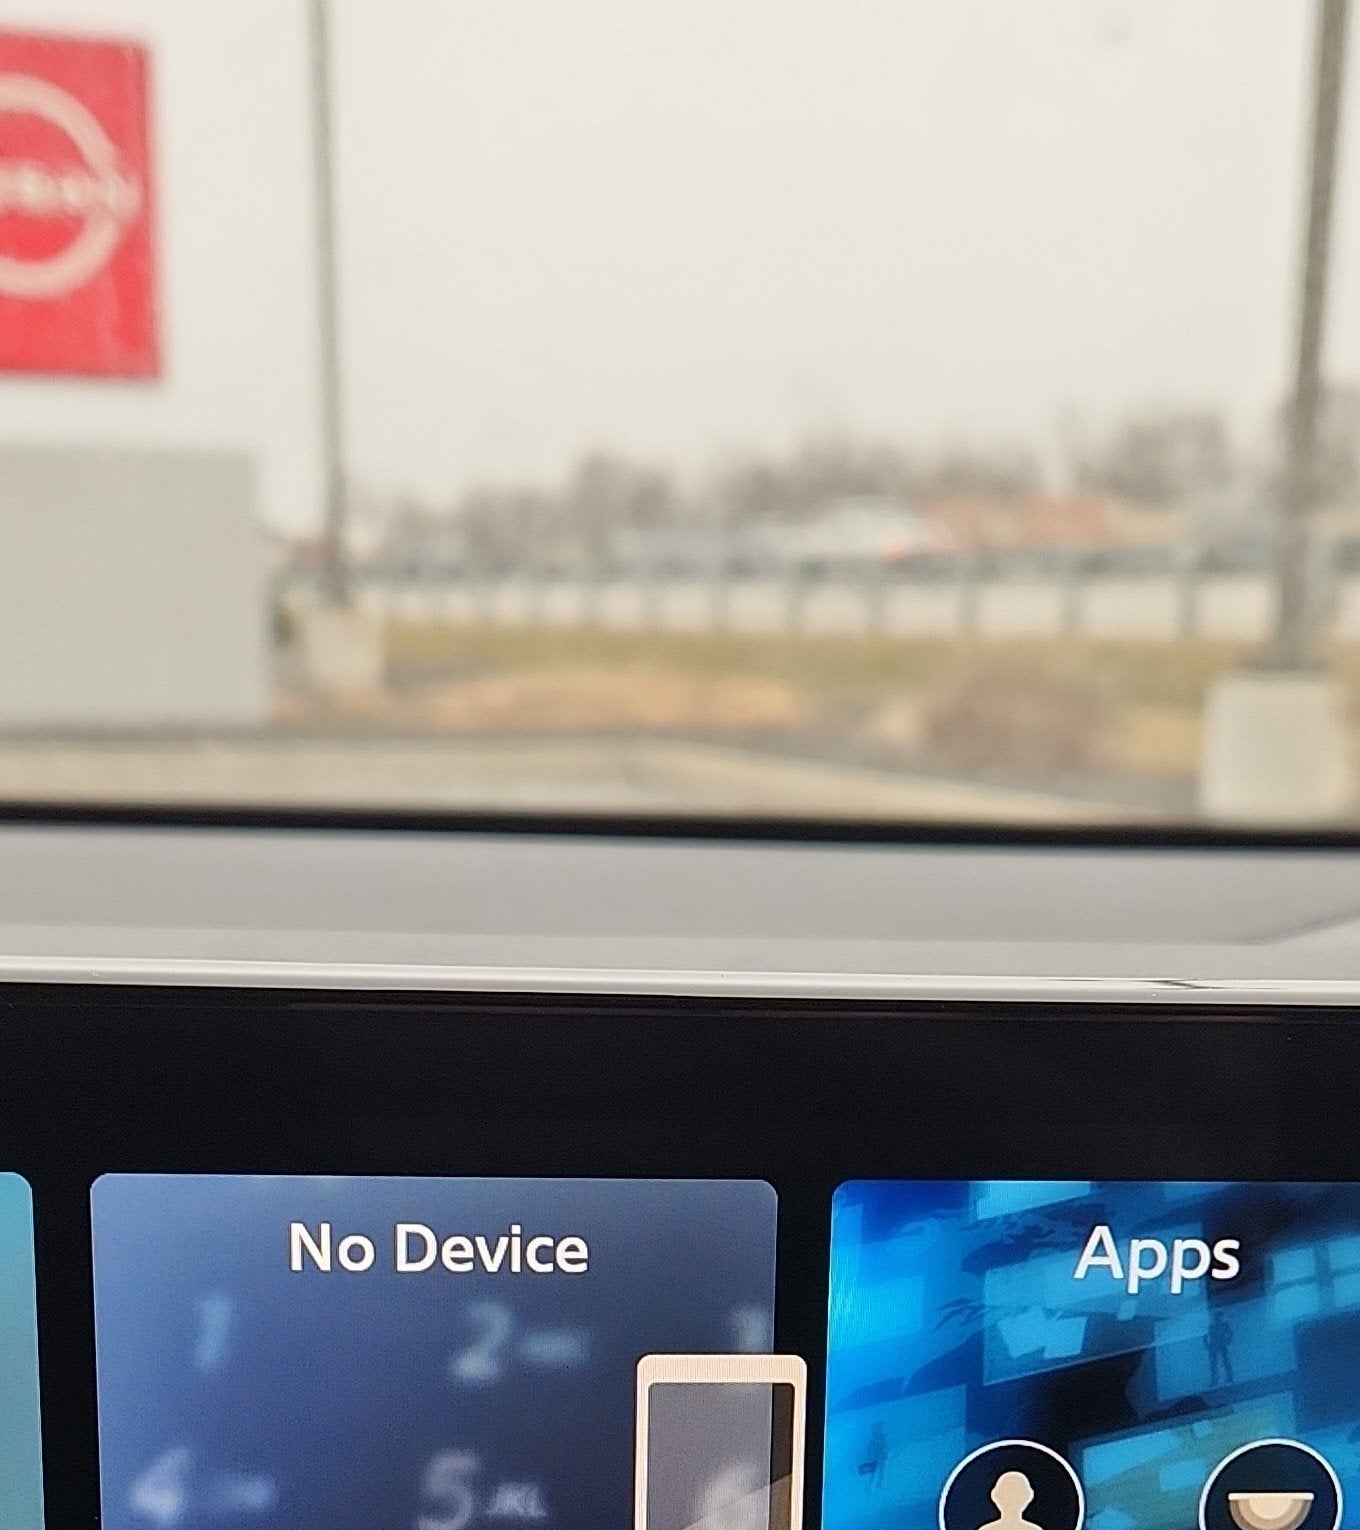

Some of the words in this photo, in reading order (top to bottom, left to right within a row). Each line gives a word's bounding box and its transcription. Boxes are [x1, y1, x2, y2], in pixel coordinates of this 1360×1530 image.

[289, 1223, 375, 1272] No
[395, 1223, 589, 1274] Device
[1074, 1225, 1241, 1294] Apps
[451, 1300, 511, 1381] 2
